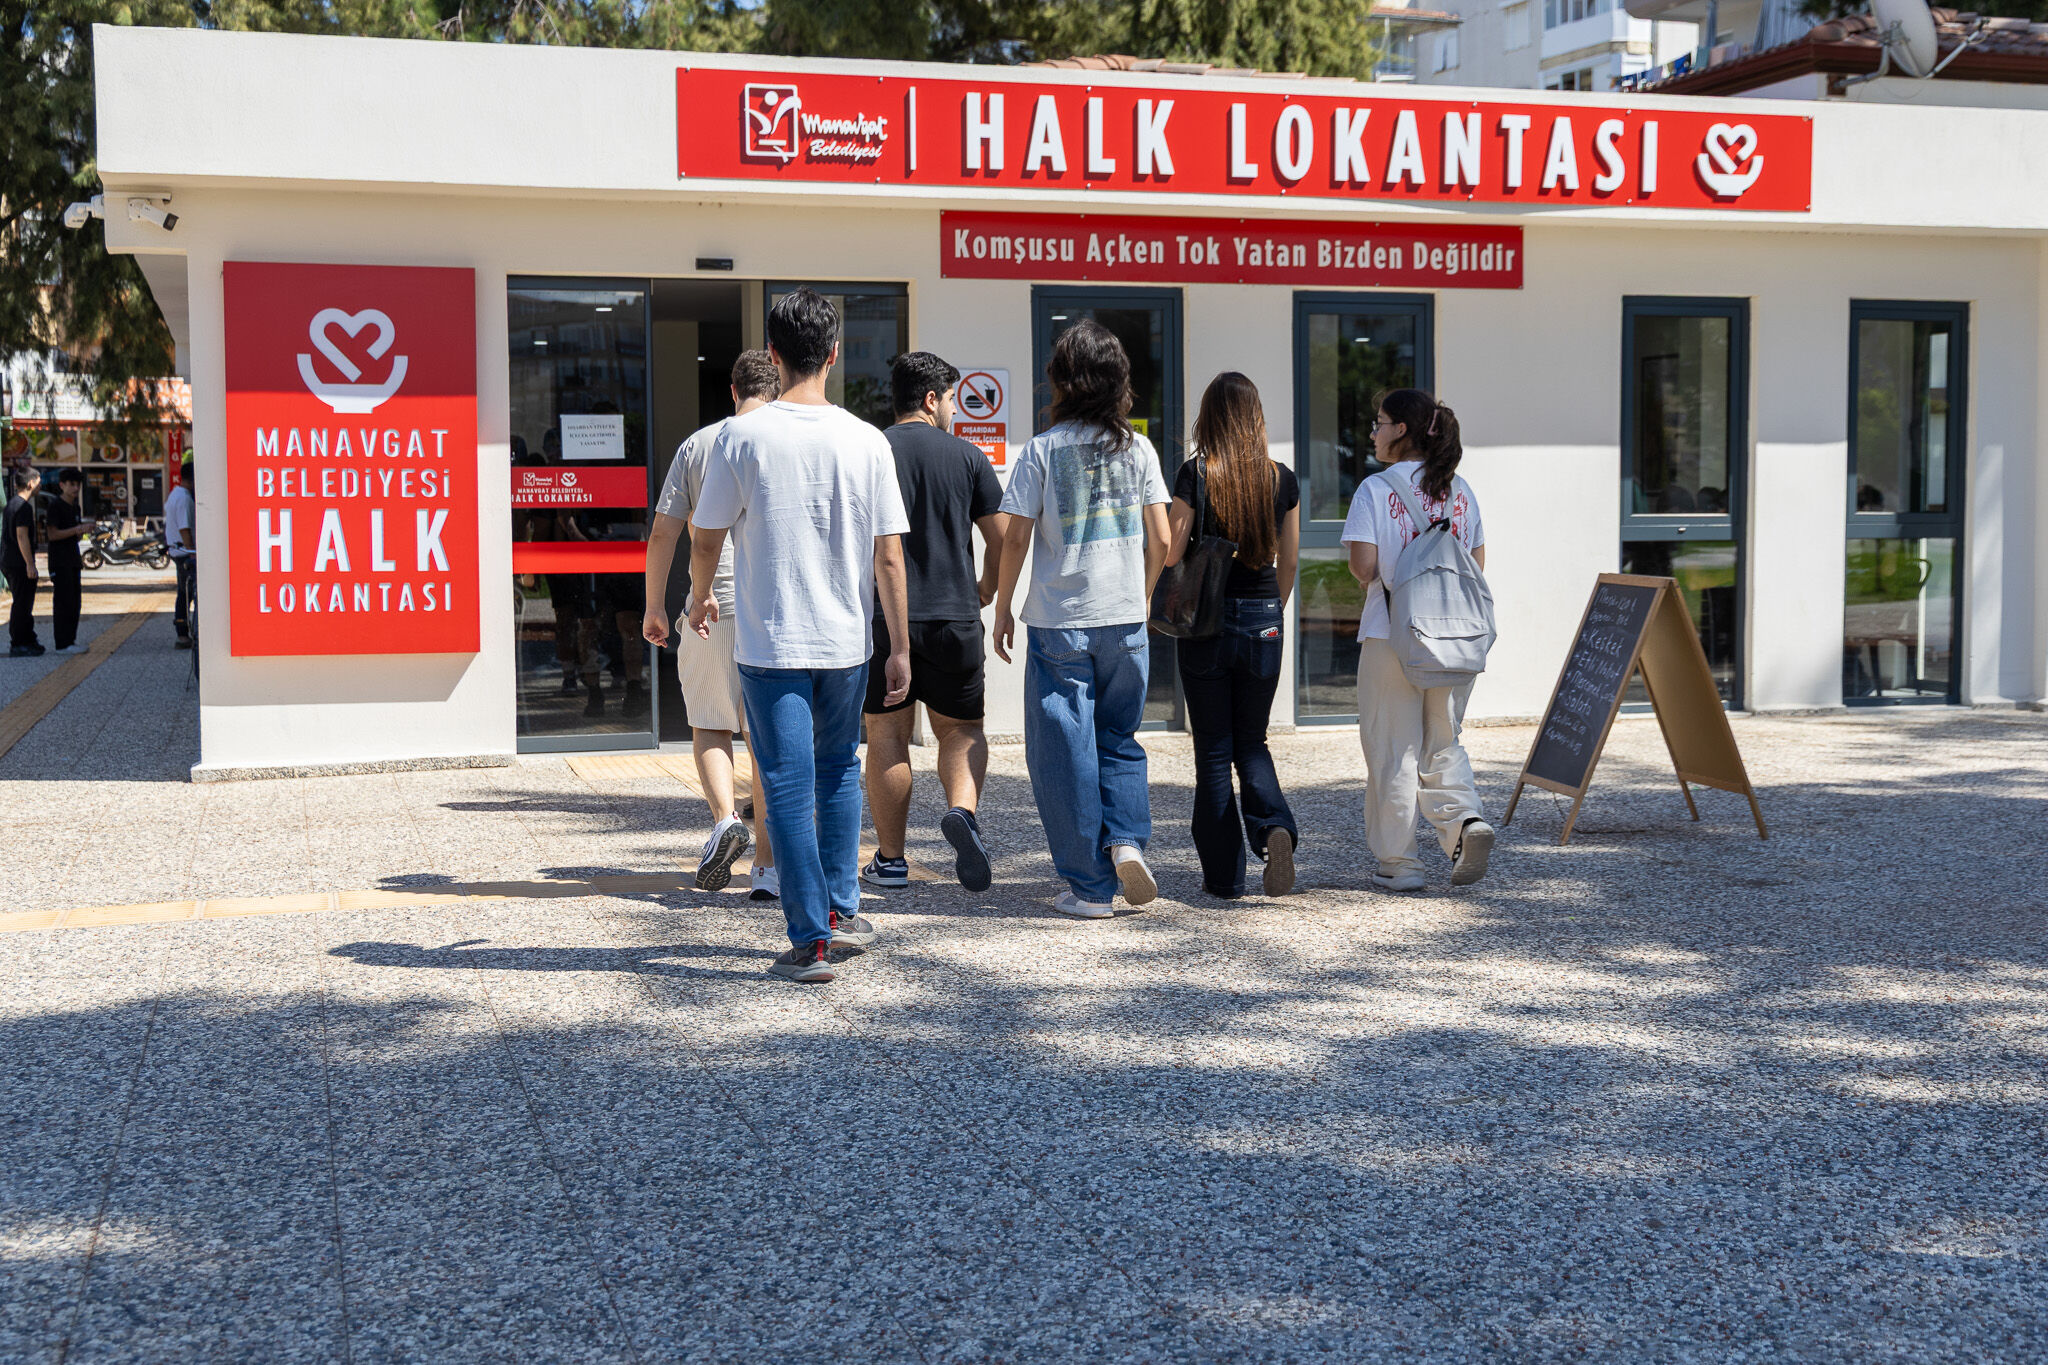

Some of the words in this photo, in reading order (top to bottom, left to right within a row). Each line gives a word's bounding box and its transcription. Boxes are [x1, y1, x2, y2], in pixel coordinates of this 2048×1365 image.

[809, 139, 882, 161] Belediyesi
[965, 91, 1175, 175] HALK
[1231, 102, 1658, 193] LOKANTASI
[954, 229, 1074, 264] Komşusu
[1086, 233, 1164, 267] Açken
[1176, 236, 1220, 265] Tok
[1233, 237, 1306, 267] Yatan
[1317, 239, 1402, 269] Bizden
[1413, 242, 1515, 275] Değildir
[256, 427, 449, 458] MANAVGAT
[538, 493, 593, 503] LOKANTASI
[258, 508, 450, 573] HALK
[259, 582, 452, 613] LOKANTASI
